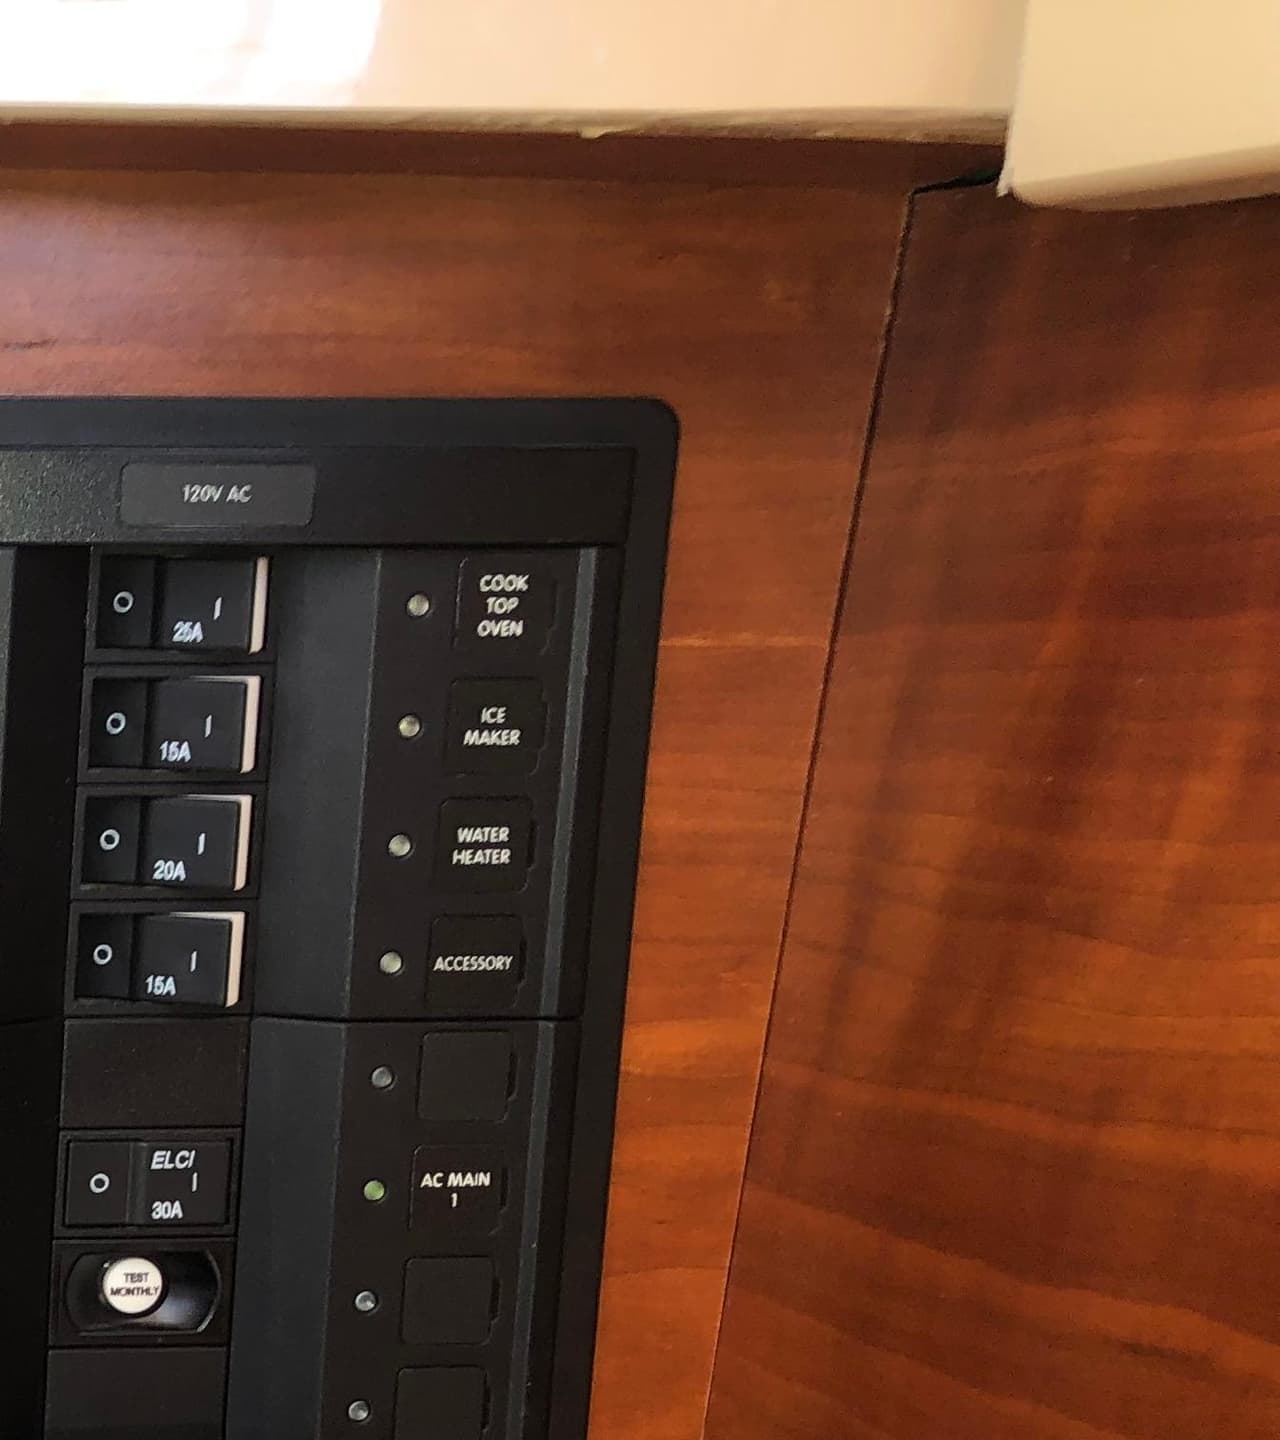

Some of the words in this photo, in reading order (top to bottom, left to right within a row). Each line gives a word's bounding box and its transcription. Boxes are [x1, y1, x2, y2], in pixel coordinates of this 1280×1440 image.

[184, 485, 223, 502] 120V
[226, 485, 251, 502] AC
[480, 574, 528, 591] COOK
[487, 597, 518, 614] TOP
[173, 621, 203, 642] 25A
[478, 620, 523, 636] OVEN
[481, 707, 506, 723] ICE
[464, 729, 520, 745] MAKER
[160, 741, 191, 762] 15A
[458, 827, 509, 844] WATER
[453, 849, 510, 864] HEATER
[153, 860, 185, 880] 20A
[434, 956, 513, 971] ACCESSORY
[146, 975, 175, 995] 15A
[151, 1150, 195, 1169] ELCI
[421, 1173, 443, 1187] AC
[448, 1172, 490, 1187] MAIN
[452, 1193, 457, 1207] 1
[152, 1201, 182, 1219] 30A
[123, 1272, 150, 1284] TEST
[110, 1285, 160, 1298] MONTHLY
